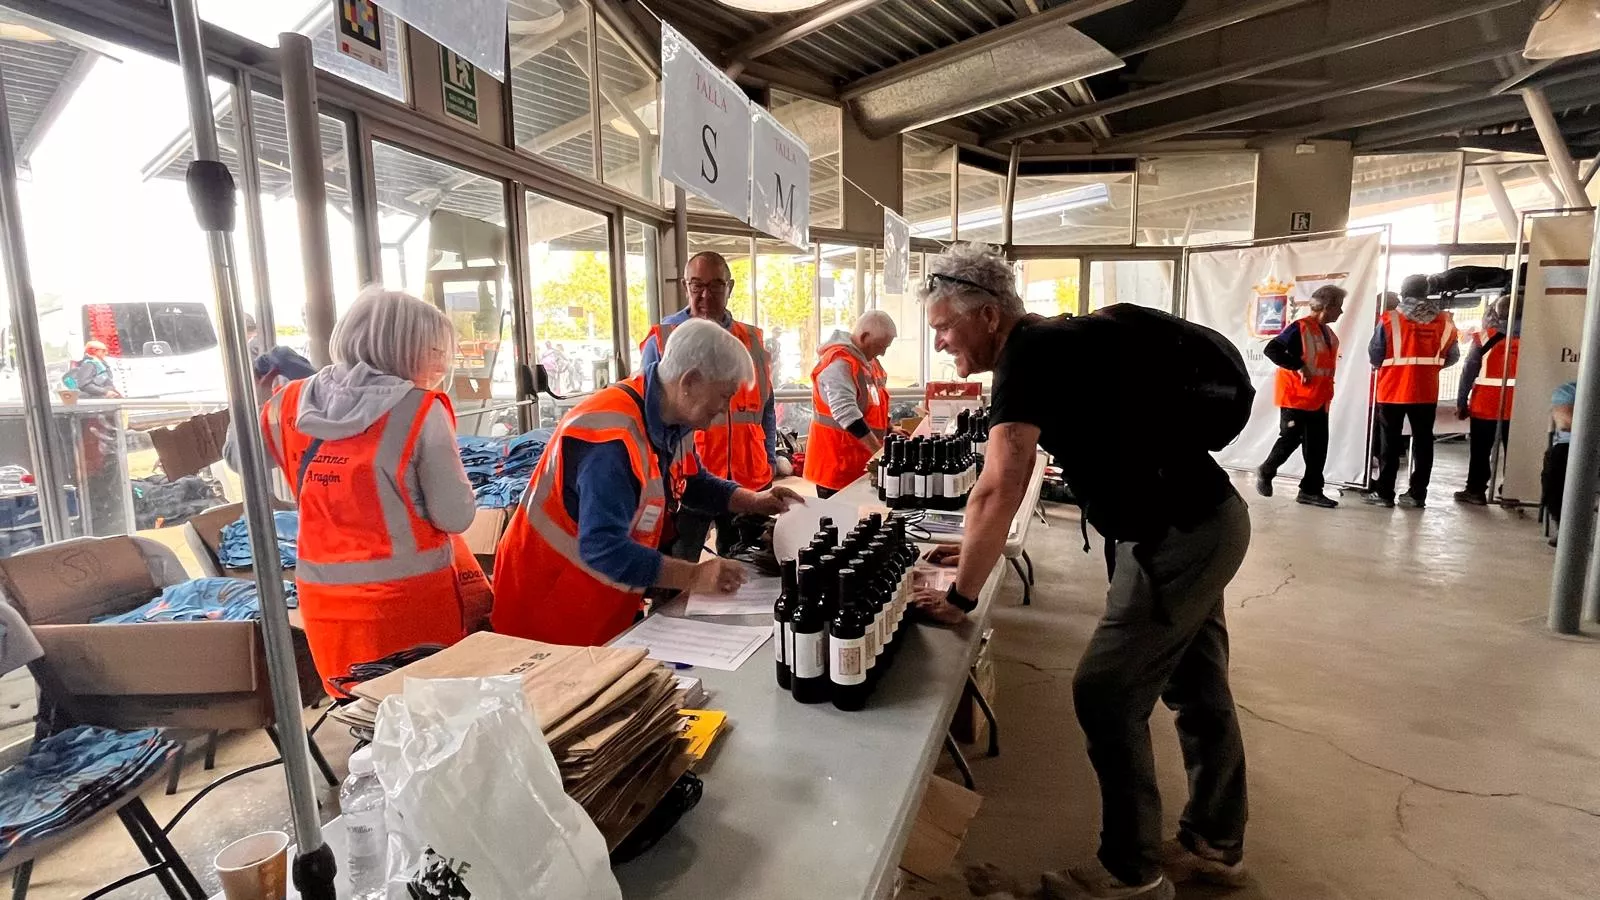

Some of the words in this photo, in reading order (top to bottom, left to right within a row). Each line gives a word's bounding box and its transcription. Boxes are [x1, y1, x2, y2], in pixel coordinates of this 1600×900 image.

[696, 72, 727, 113] TALLA
[701, 124, 719, 184] S
[774, 137, 797, 165] TALLA
[774, 172, 796, 228] M
[1560, 347, 1581, 363] Pa
[306, 470, 341, 487] Aragón
